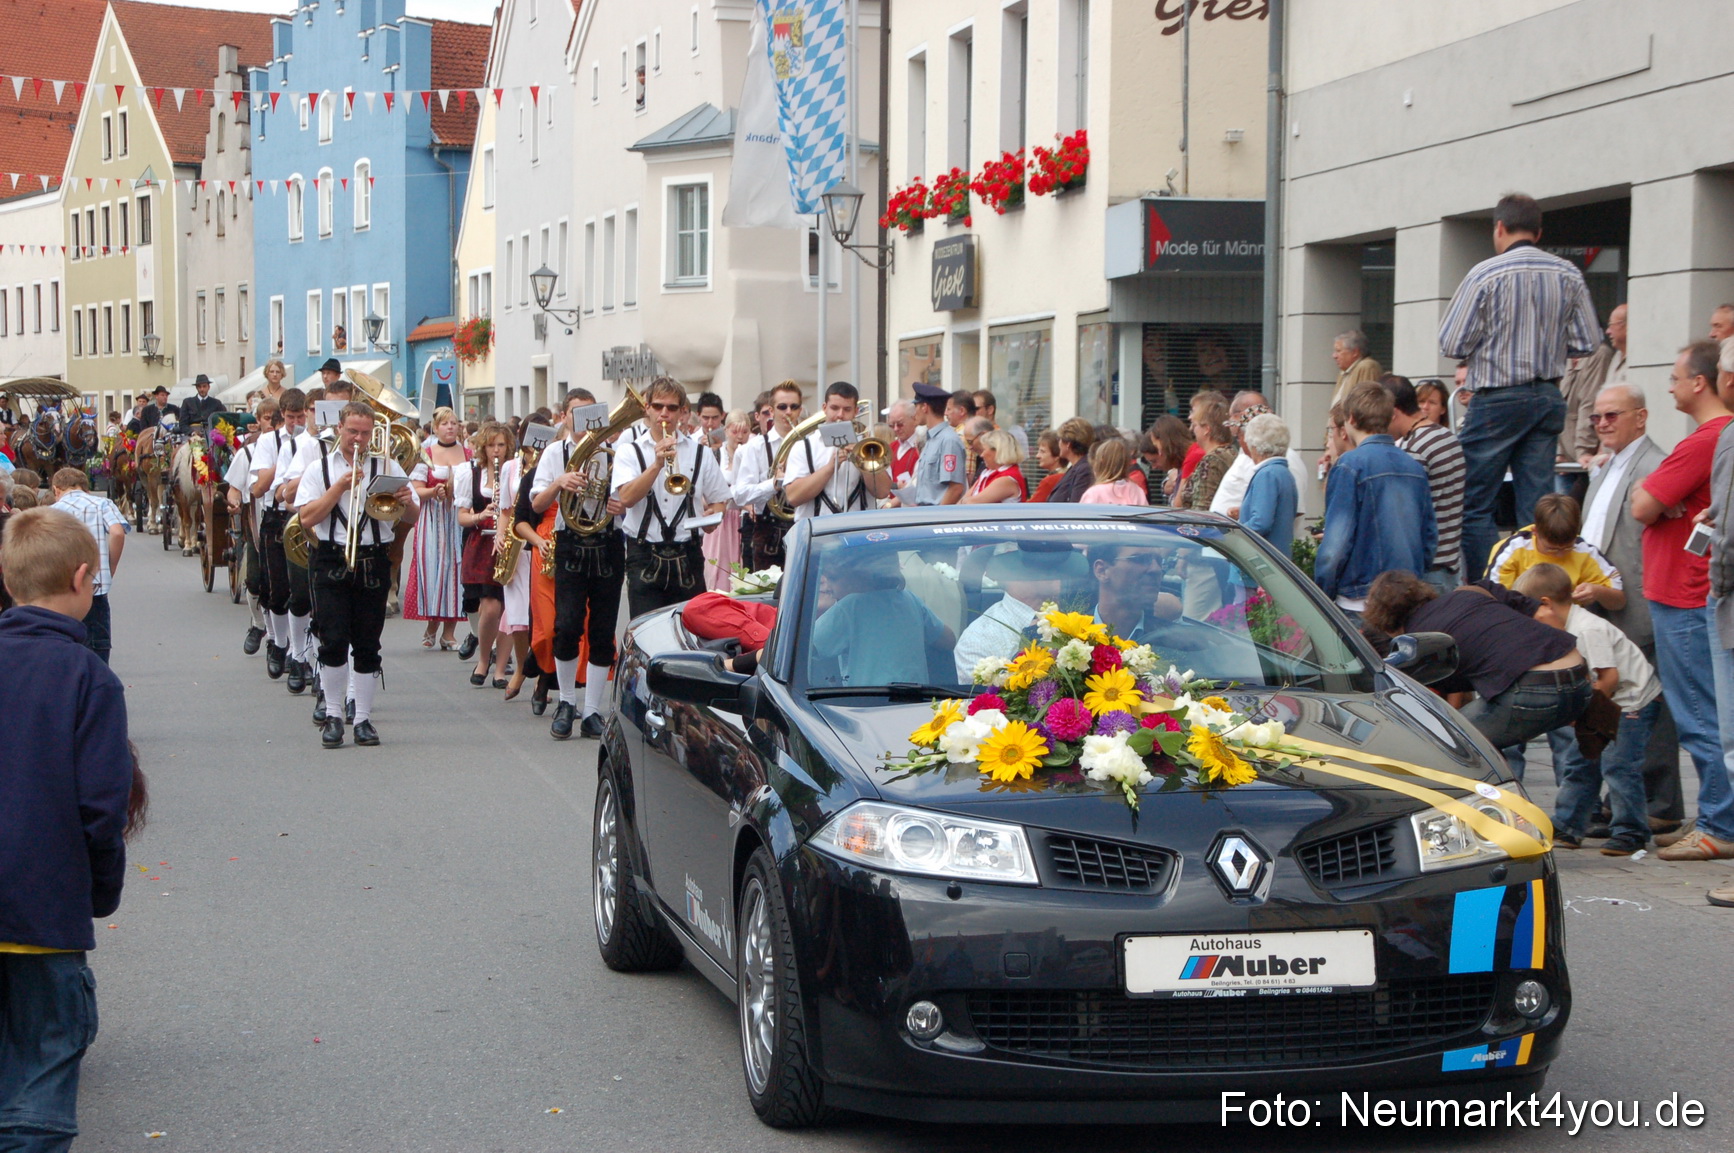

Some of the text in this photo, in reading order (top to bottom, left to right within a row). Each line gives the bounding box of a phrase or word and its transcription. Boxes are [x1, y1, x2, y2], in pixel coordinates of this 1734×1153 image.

[1156, 241, 1198, 255] Mode
[1202, 240, 1221, 255] für
[933, 525, 999, 535] RENAULT
[1030, 524, 1138, 532] WELTMEISTER
[1190, 938, 1262, 951] Autohaus
[1211, 955, 1327, 977] Nuber
[1471, 1051, 1507, 1063] Nuber
